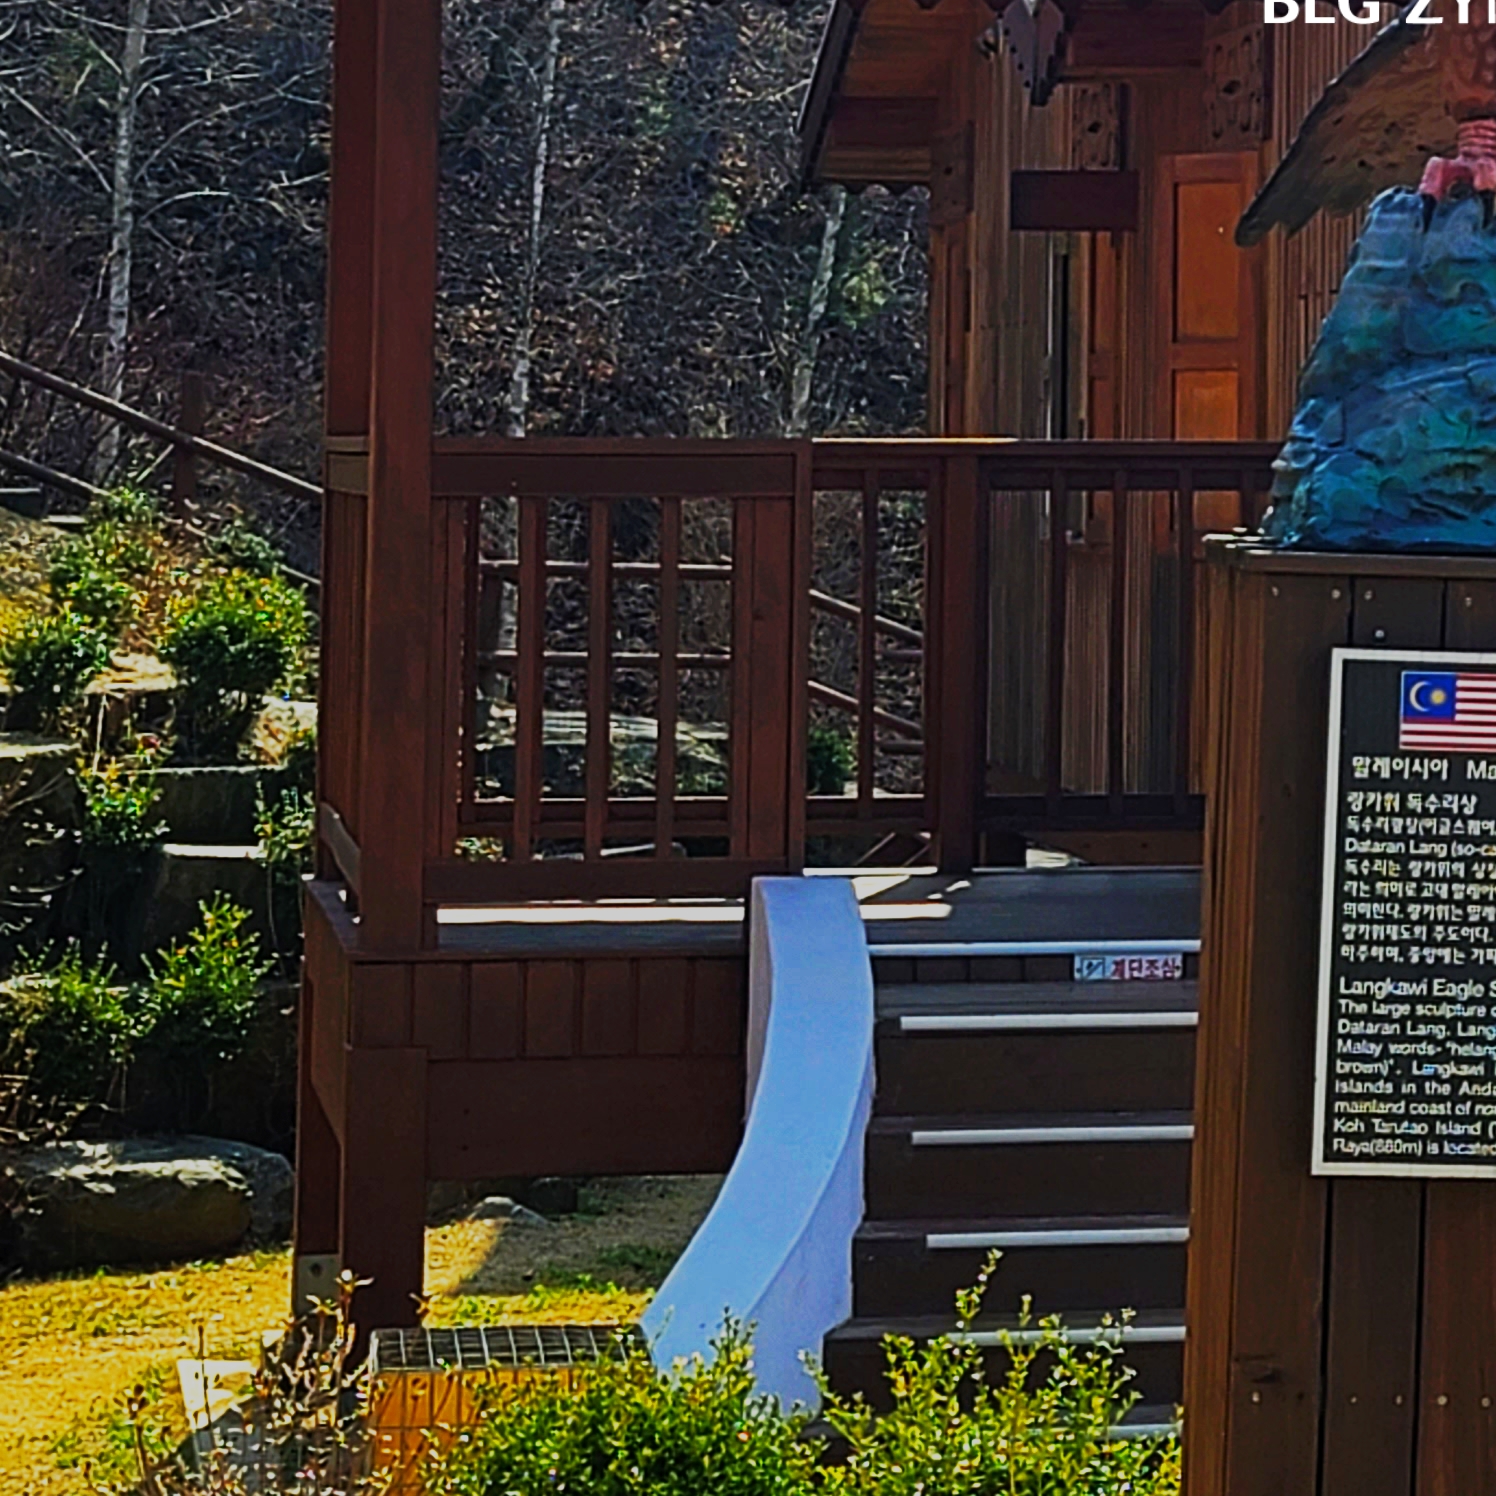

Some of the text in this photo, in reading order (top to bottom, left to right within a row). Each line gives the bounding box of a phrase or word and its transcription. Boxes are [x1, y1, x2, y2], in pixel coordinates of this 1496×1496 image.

[1352, 756, 1448, 781] 말레이시아
[1407, 793, 1478, 814] 독수리상
[1344, 837, 1406, 854] Dataran
[1409, 839, 1448, 858] Lang
[1111, 957, 1176, 979] 계단조심
[1340, 976, 1428, 1000] Langkawi
[1432, 979, 1486, 1002] Eagle
[1339, 999, 1368, 1015] The
[1371, 1001, 1411, 1020] large
[1415, 1002, 1487, 1020] sculpture
[1337, 1018, 1400, 1035] Dataran
[1337, 1038, 1383, 1058] Malay
[1411, 1060, 1486, 1080] Langkawi
[1402, 1080, 1417, 1095] in
[1424, 1081, 1451, 1096] the
[1334, 1100, 1406, 1114] mainland
[1409, 1103, 1452, 1116] coast
[1455, 1101, 1472, 1116] of
[1333, 1117, 1365, 1133] Koh
[1435, 1121, 1482, 1136] Island
[1427, 1141, 1440, 1155] is
